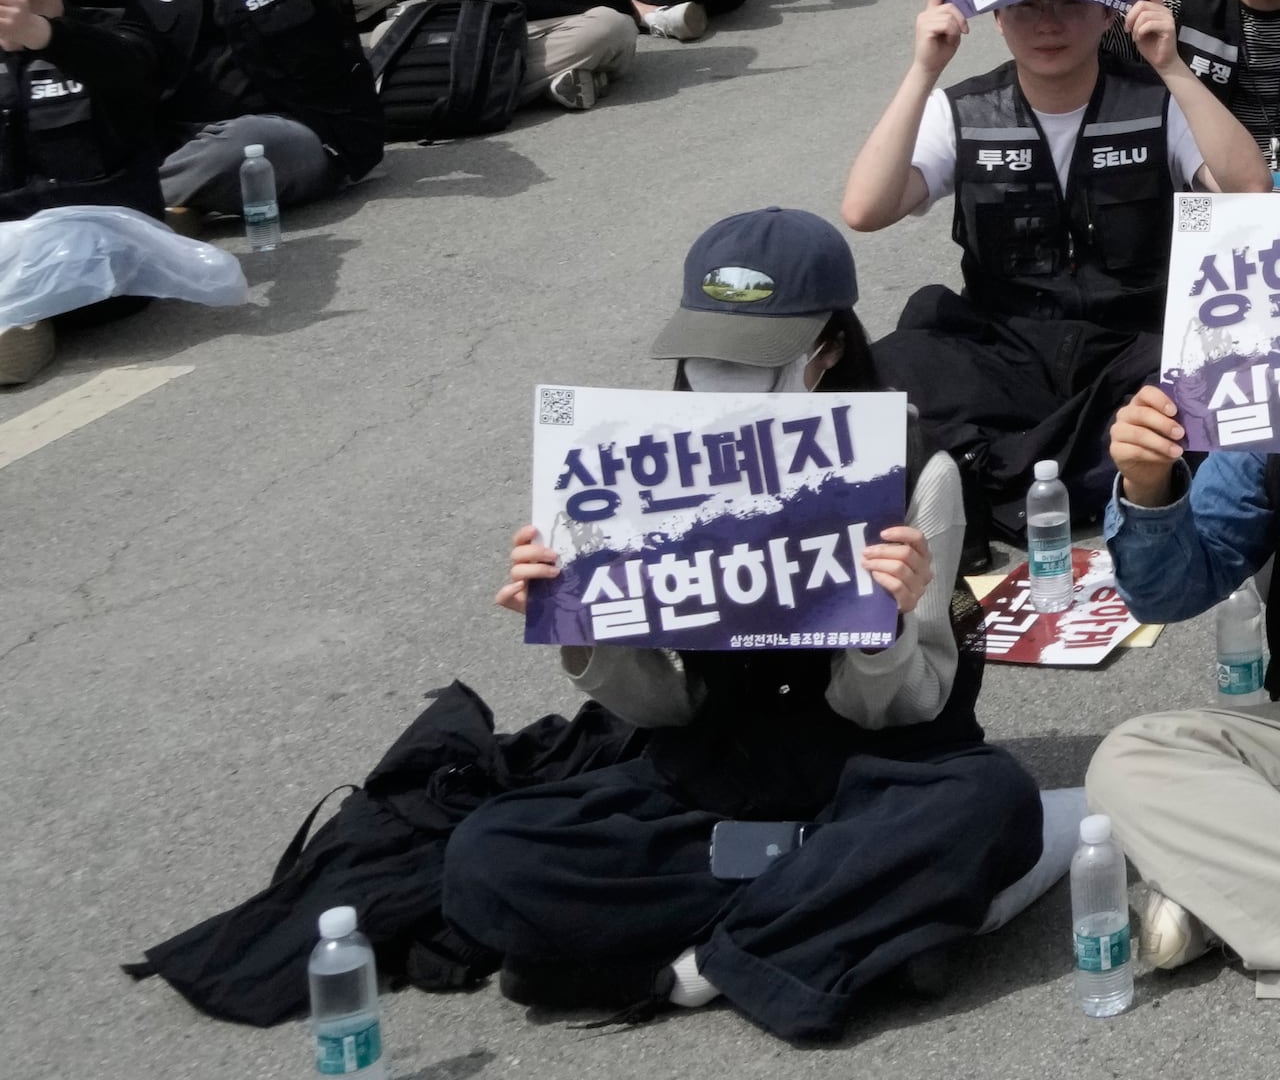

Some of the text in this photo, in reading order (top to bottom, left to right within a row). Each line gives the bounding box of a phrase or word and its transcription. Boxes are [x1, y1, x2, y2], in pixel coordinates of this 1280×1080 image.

[1189, 57, 1232, 84] 투쟁
[31, 80, 83, 99] SELU
[976, 148, 1033, 172] 투쟁
[1092, 147, 1148, 169] SELU
[554, 404, 859, 522] 상한폐지
[581, 522, 877, 643] 실현하자
[730, 631, 892, 647] 삼성전자노동조합 공동투쟁본부
